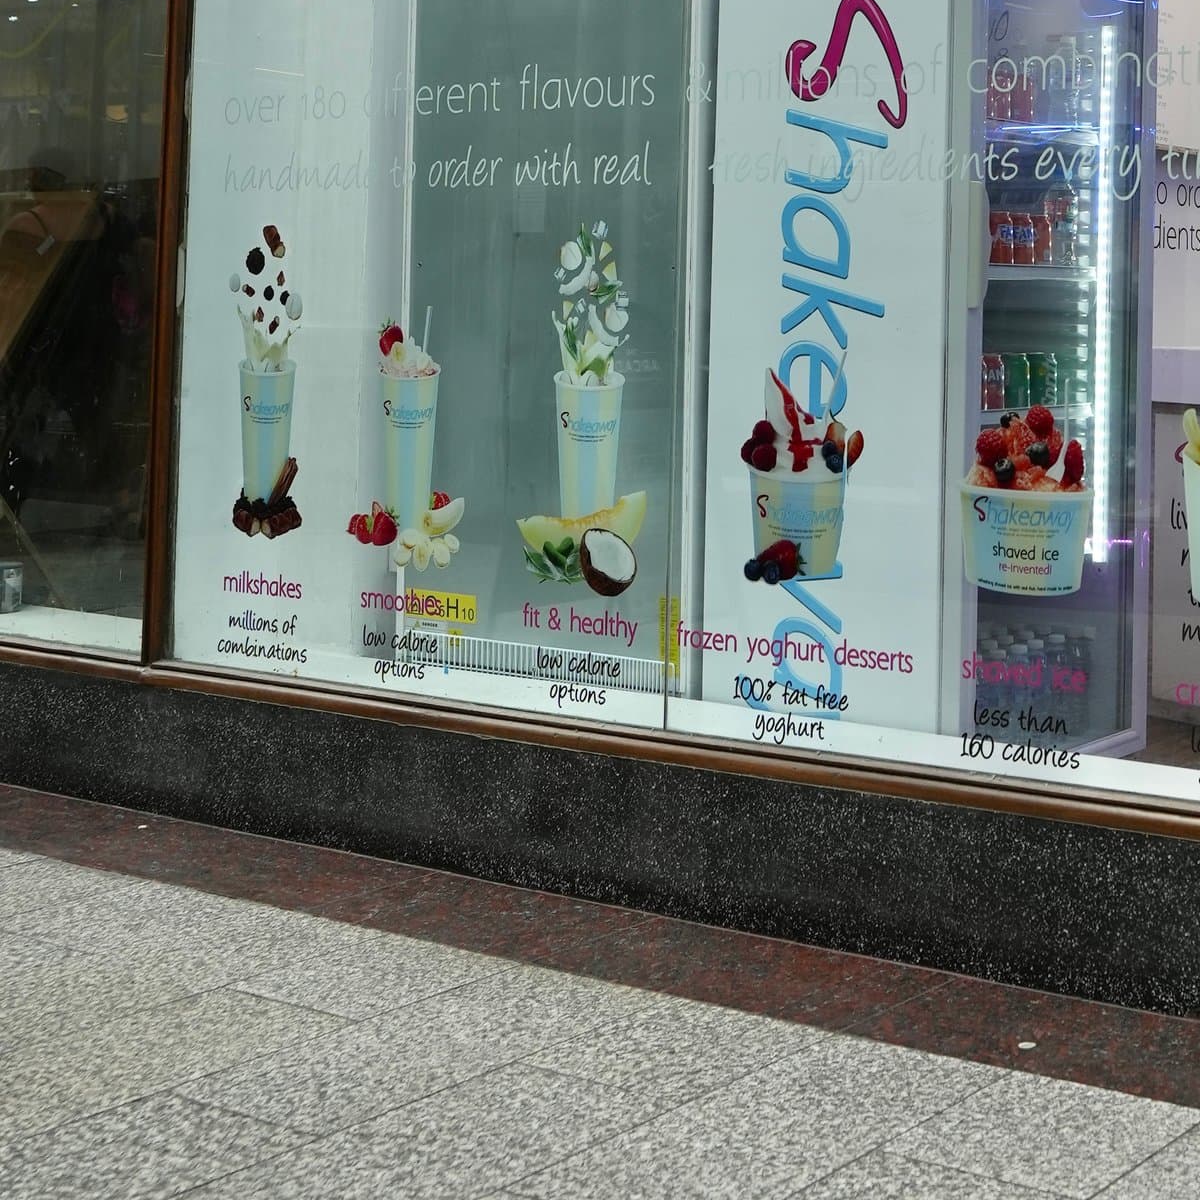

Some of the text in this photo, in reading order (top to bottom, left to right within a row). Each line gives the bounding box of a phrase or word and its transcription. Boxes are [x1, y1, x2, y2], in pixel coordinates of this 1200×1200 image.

[686, 63, 713, 103] &
[901, 43, 944, 94] of
[224, 90, 286, 125] over
[519, 63, 656, 110] flavours
[428, 145, 503, 190] order
[515, 142, 582, 188] with
[592, 140, 653, 187] real
[1034, 143, 1142, 201] every
[973, 495, 1077, 534] Shakeaway
[992, 541, 1060, 561] shaved ice
[223, 570, 302, 600] milkshakes
[998, 562, 1052, 576] re-invented!
[360, 588, 442, 616] smoothies
[229, 610, 298, 635] millions of
[362, 623, 438, 654] low calorie
[523, 602, 638, 647] fit & healthy
[217, 636, 307, 664] combinations
[537, 646, 621, 678] low calorie
[676, 620, 738, 653] frozen
[746, 631, 825, 667] yoghurt
[834, 639, 913, 674] desserts
[374, 659, 426, 683] options
[962, 650, 1088, 693] shaved ice
[549, 682, 607, 709] options
[732, 675, 849, 712] 100% fat free
[752, 711, 825, 745] yoghurt
[973, 699, 1069, 735] less than
[960, 732, 1081, 770] 160 calories
